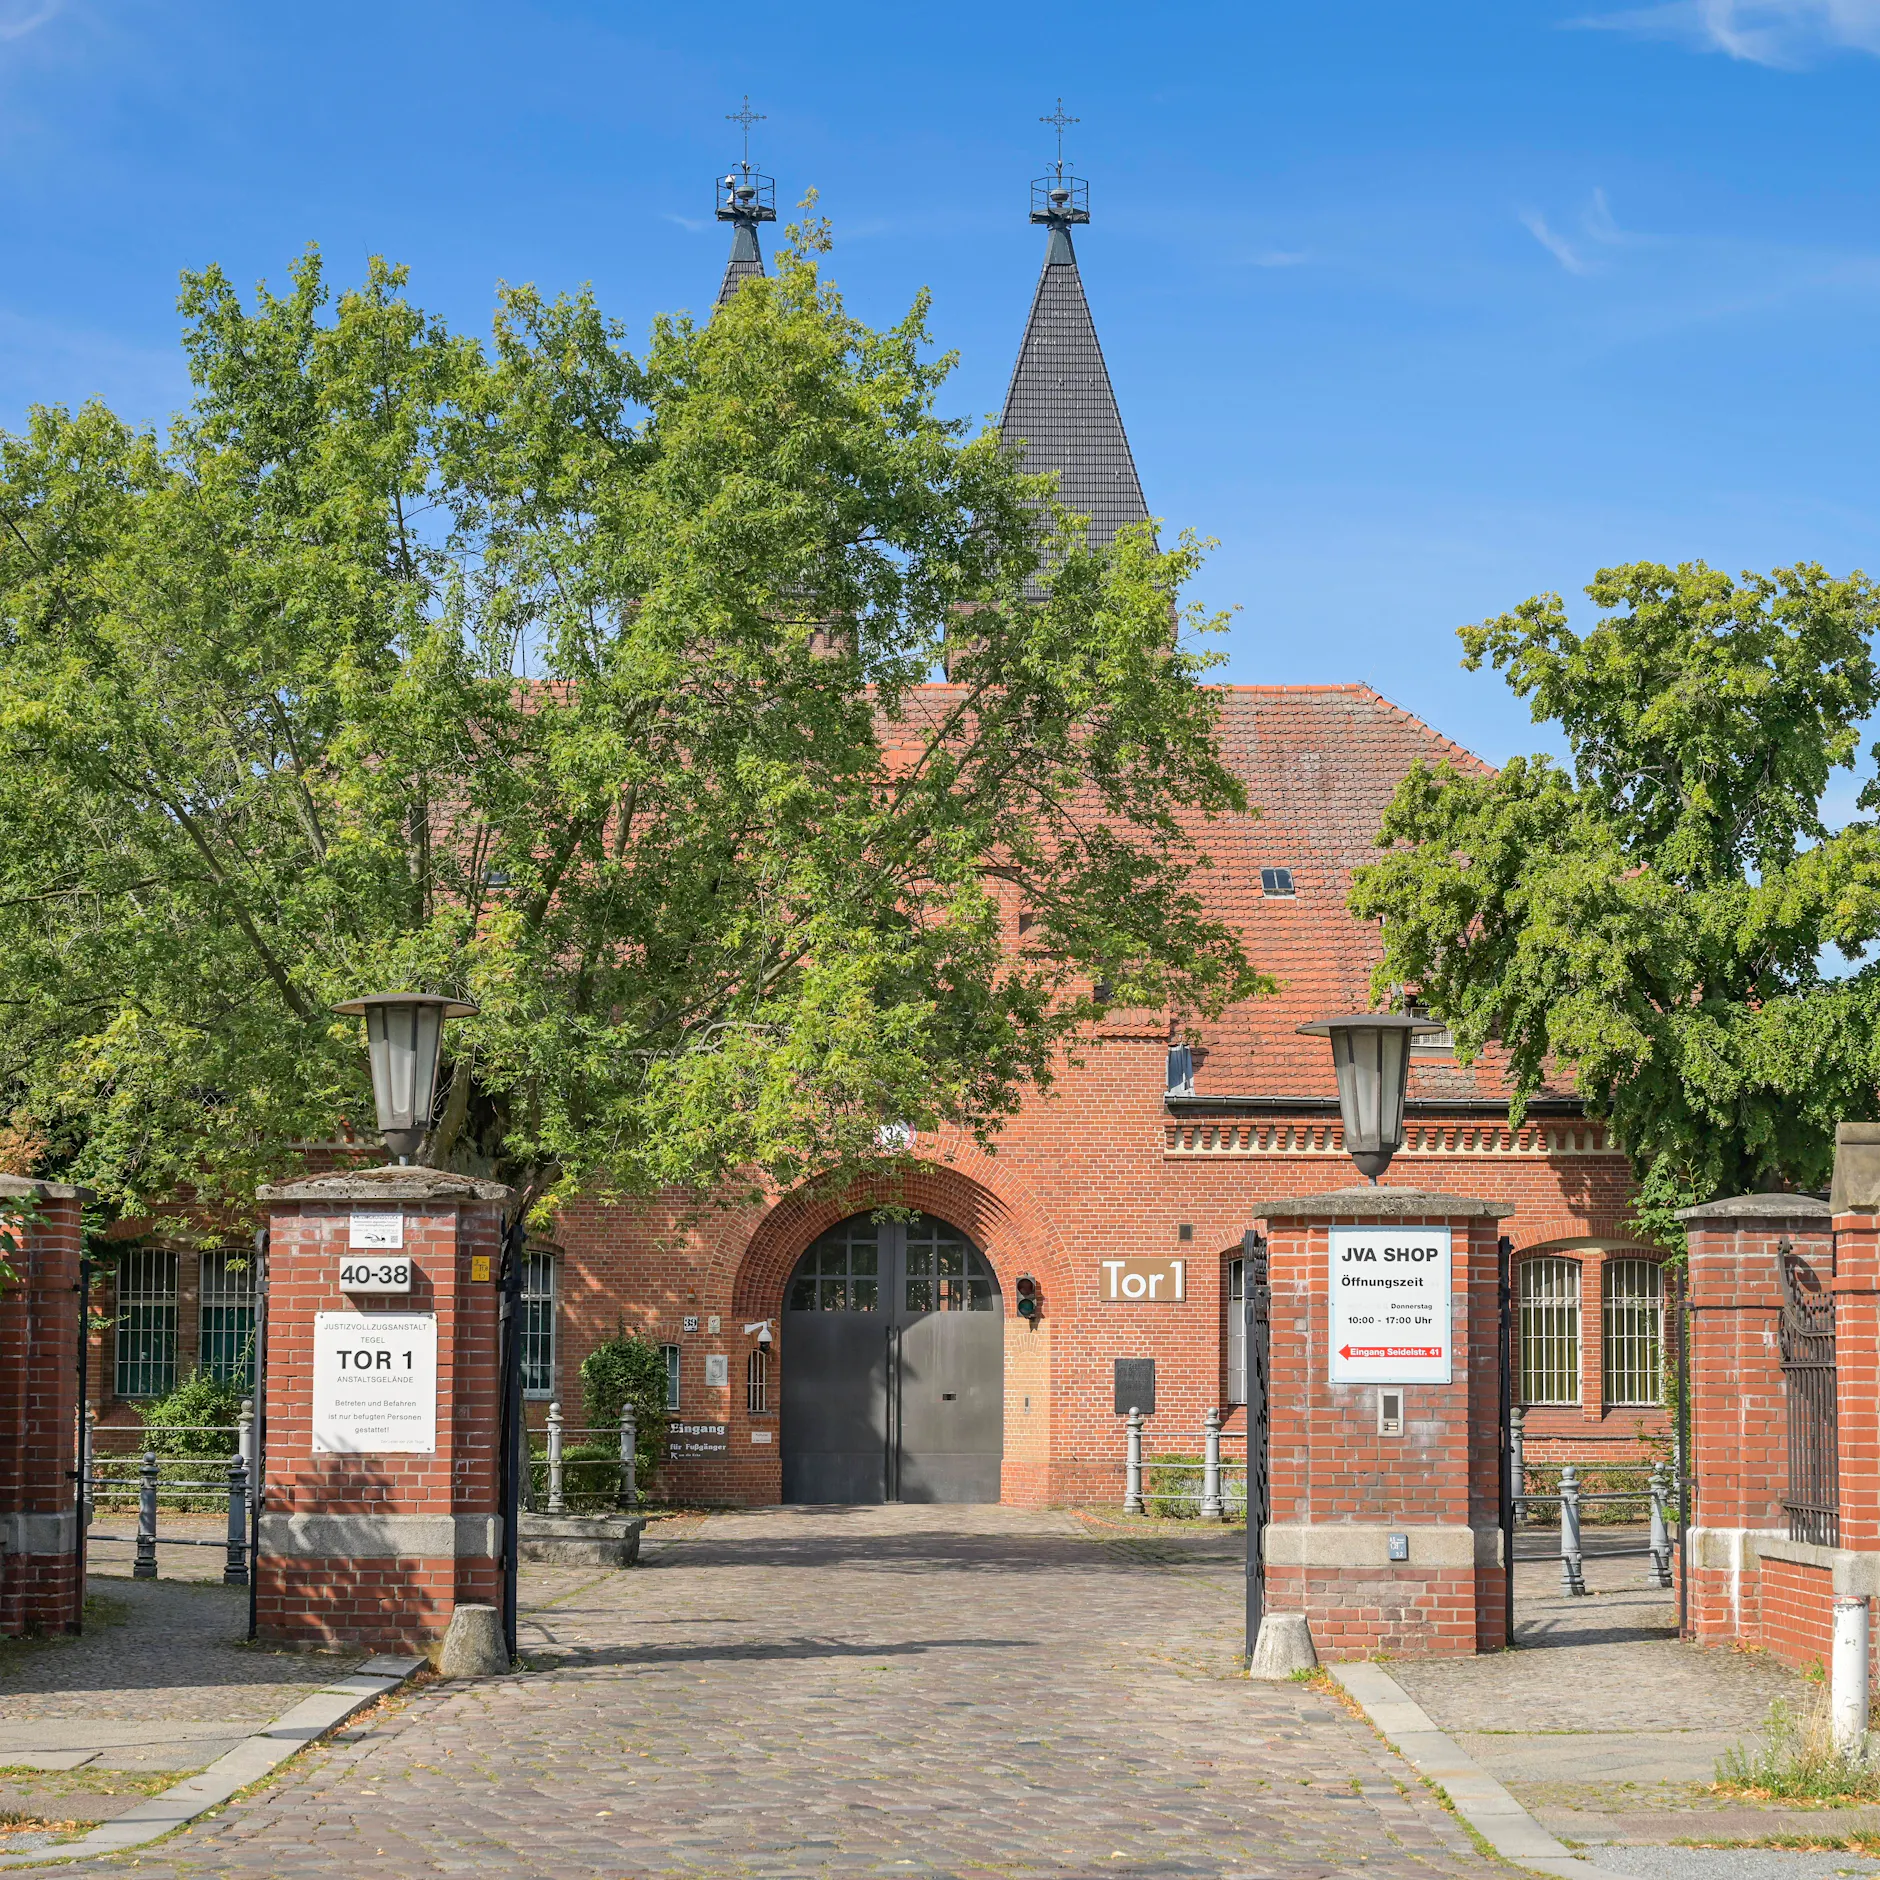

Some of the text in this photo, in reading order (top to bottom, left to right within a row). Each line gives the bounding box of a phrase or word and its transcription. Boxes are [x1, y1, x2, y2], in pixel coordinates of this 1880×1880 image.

[1341, 1247, 1439, 1262] JVA SHOP
[340, 1265, 408, 1284] 40-38
[1102, 1260, 1182, 1298] Tor 1
[1341, 1274, 1424, 1289] Öffnungszeit
[1390, 1303, 1433, 1311] Donnerstag
[684, 1318, 697, 1327] 39
[1347, 1316, 1375, 1324] 10:00
[1385, 1316, 1412, 1324] 17:00
[1414, 1316, 1433, 1324] Uhr
[323, 1323, 427, 1331] JUSTIZVOLLZUGSANSTALT
[360, 1336, 386, 1344] TEGEL
[1350, 1348, 1439, 1357] Eingang Seidelstr. 41
[336, 1350, 412, 1370] TOR 1
[336, 1375, 414, 1384] ANSTALTSGELÄNDE
[353, 1413, 385, 1421] befugten
[387, 1413, 422, 1421] Personen
[670, 1423, 725, 1436] Eingang
[685, 1443, 727, 1452] Fußgänger
